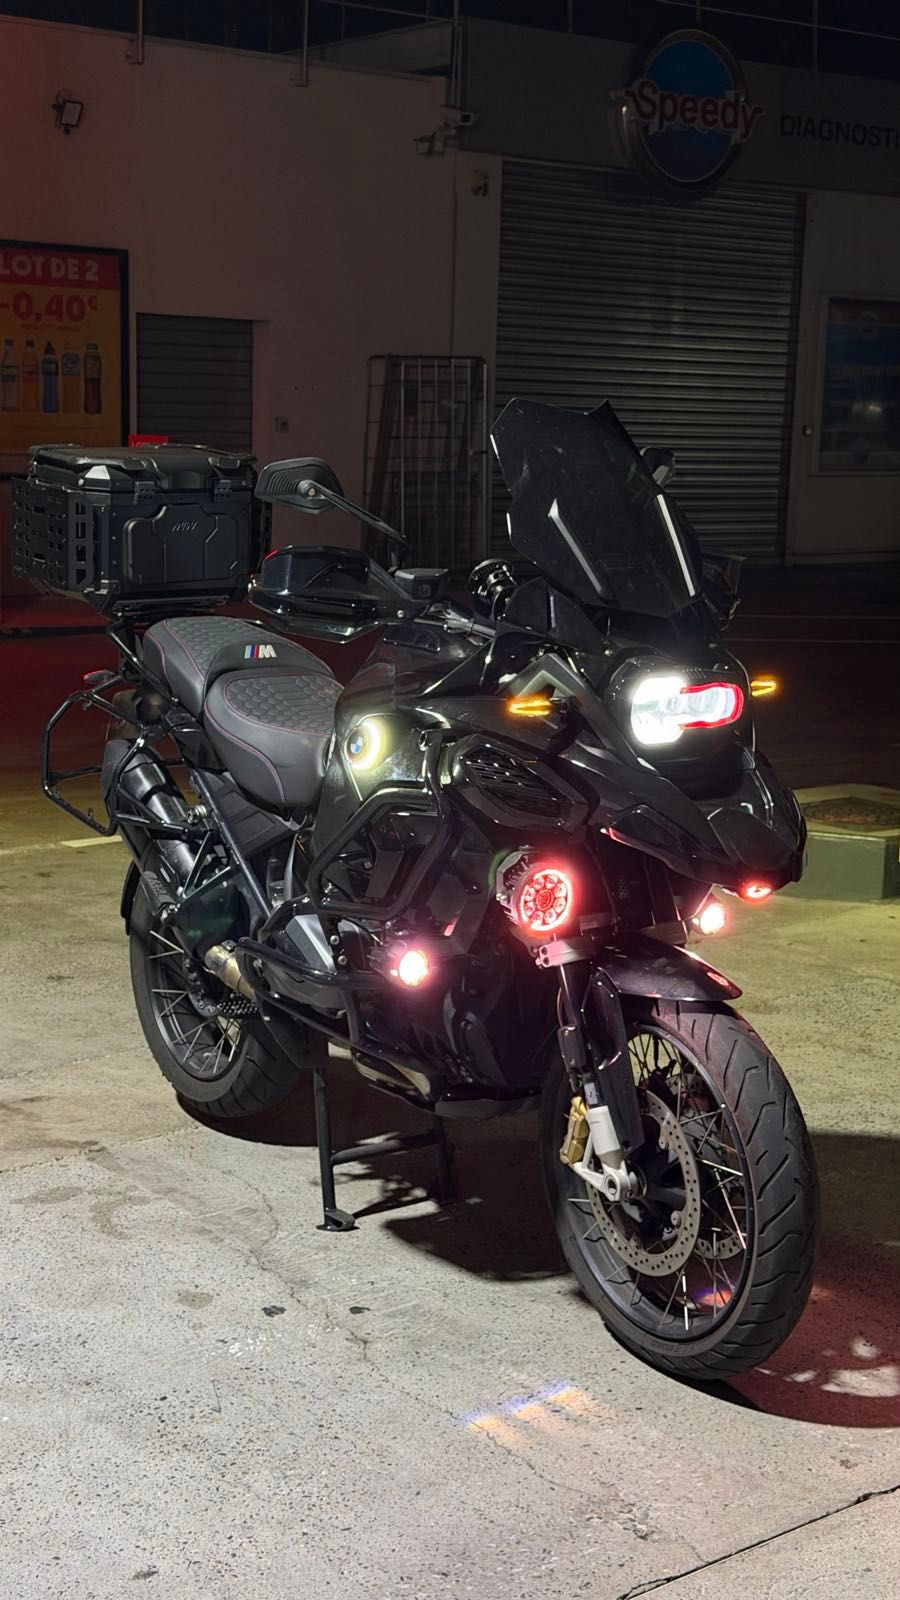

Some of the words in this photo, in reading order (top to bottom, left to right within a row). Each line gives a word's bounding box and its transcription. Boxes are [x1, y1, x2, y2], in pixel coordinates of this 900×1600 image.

[627, 80, 763, 139] Speedy
[0, 253, 46, 277] LOT
[50, 256, 80, 280] DE
[85, 259, 99, 281] 2
